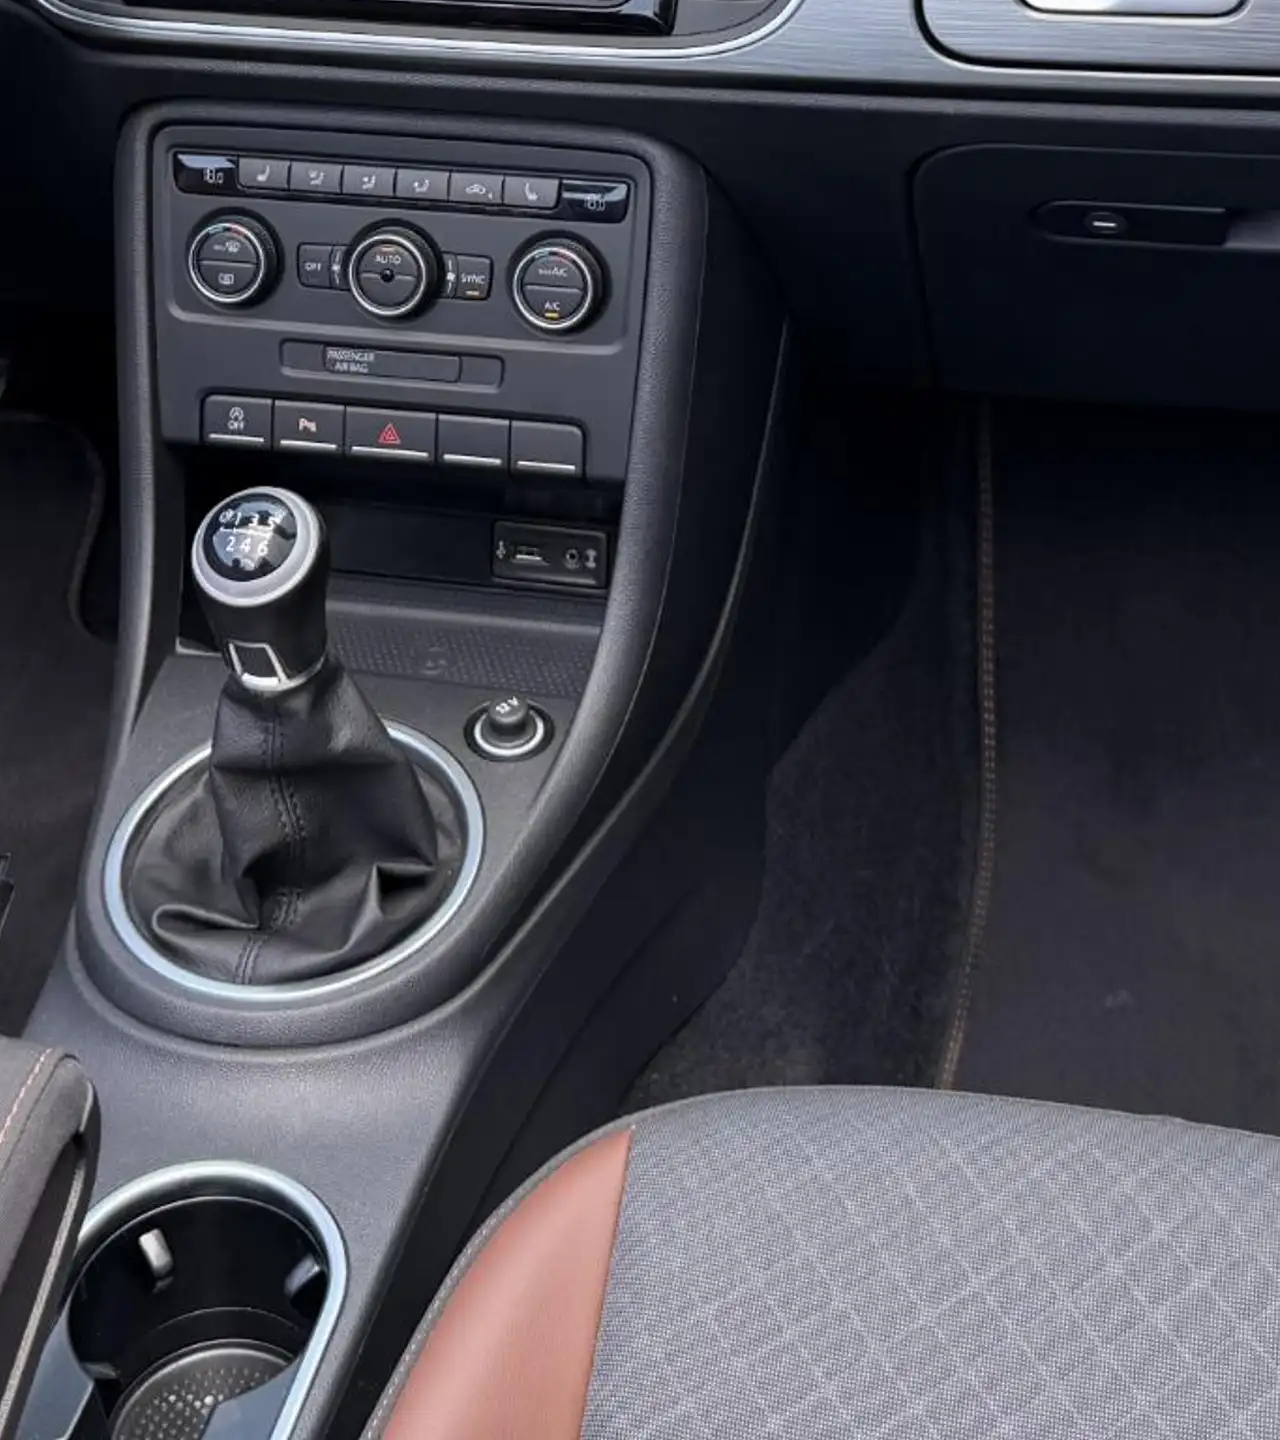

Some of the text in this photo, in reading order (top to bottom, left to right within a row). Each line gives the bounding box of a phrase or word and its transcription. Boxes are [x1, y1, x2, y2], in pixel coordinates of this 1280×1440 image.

[375, 255, 402, 265] AUTO
[305, 262, 321, 271] OFF
[461, 273, 485, 284] SYNC
[226, 536, 268, 556] 2 4 6
